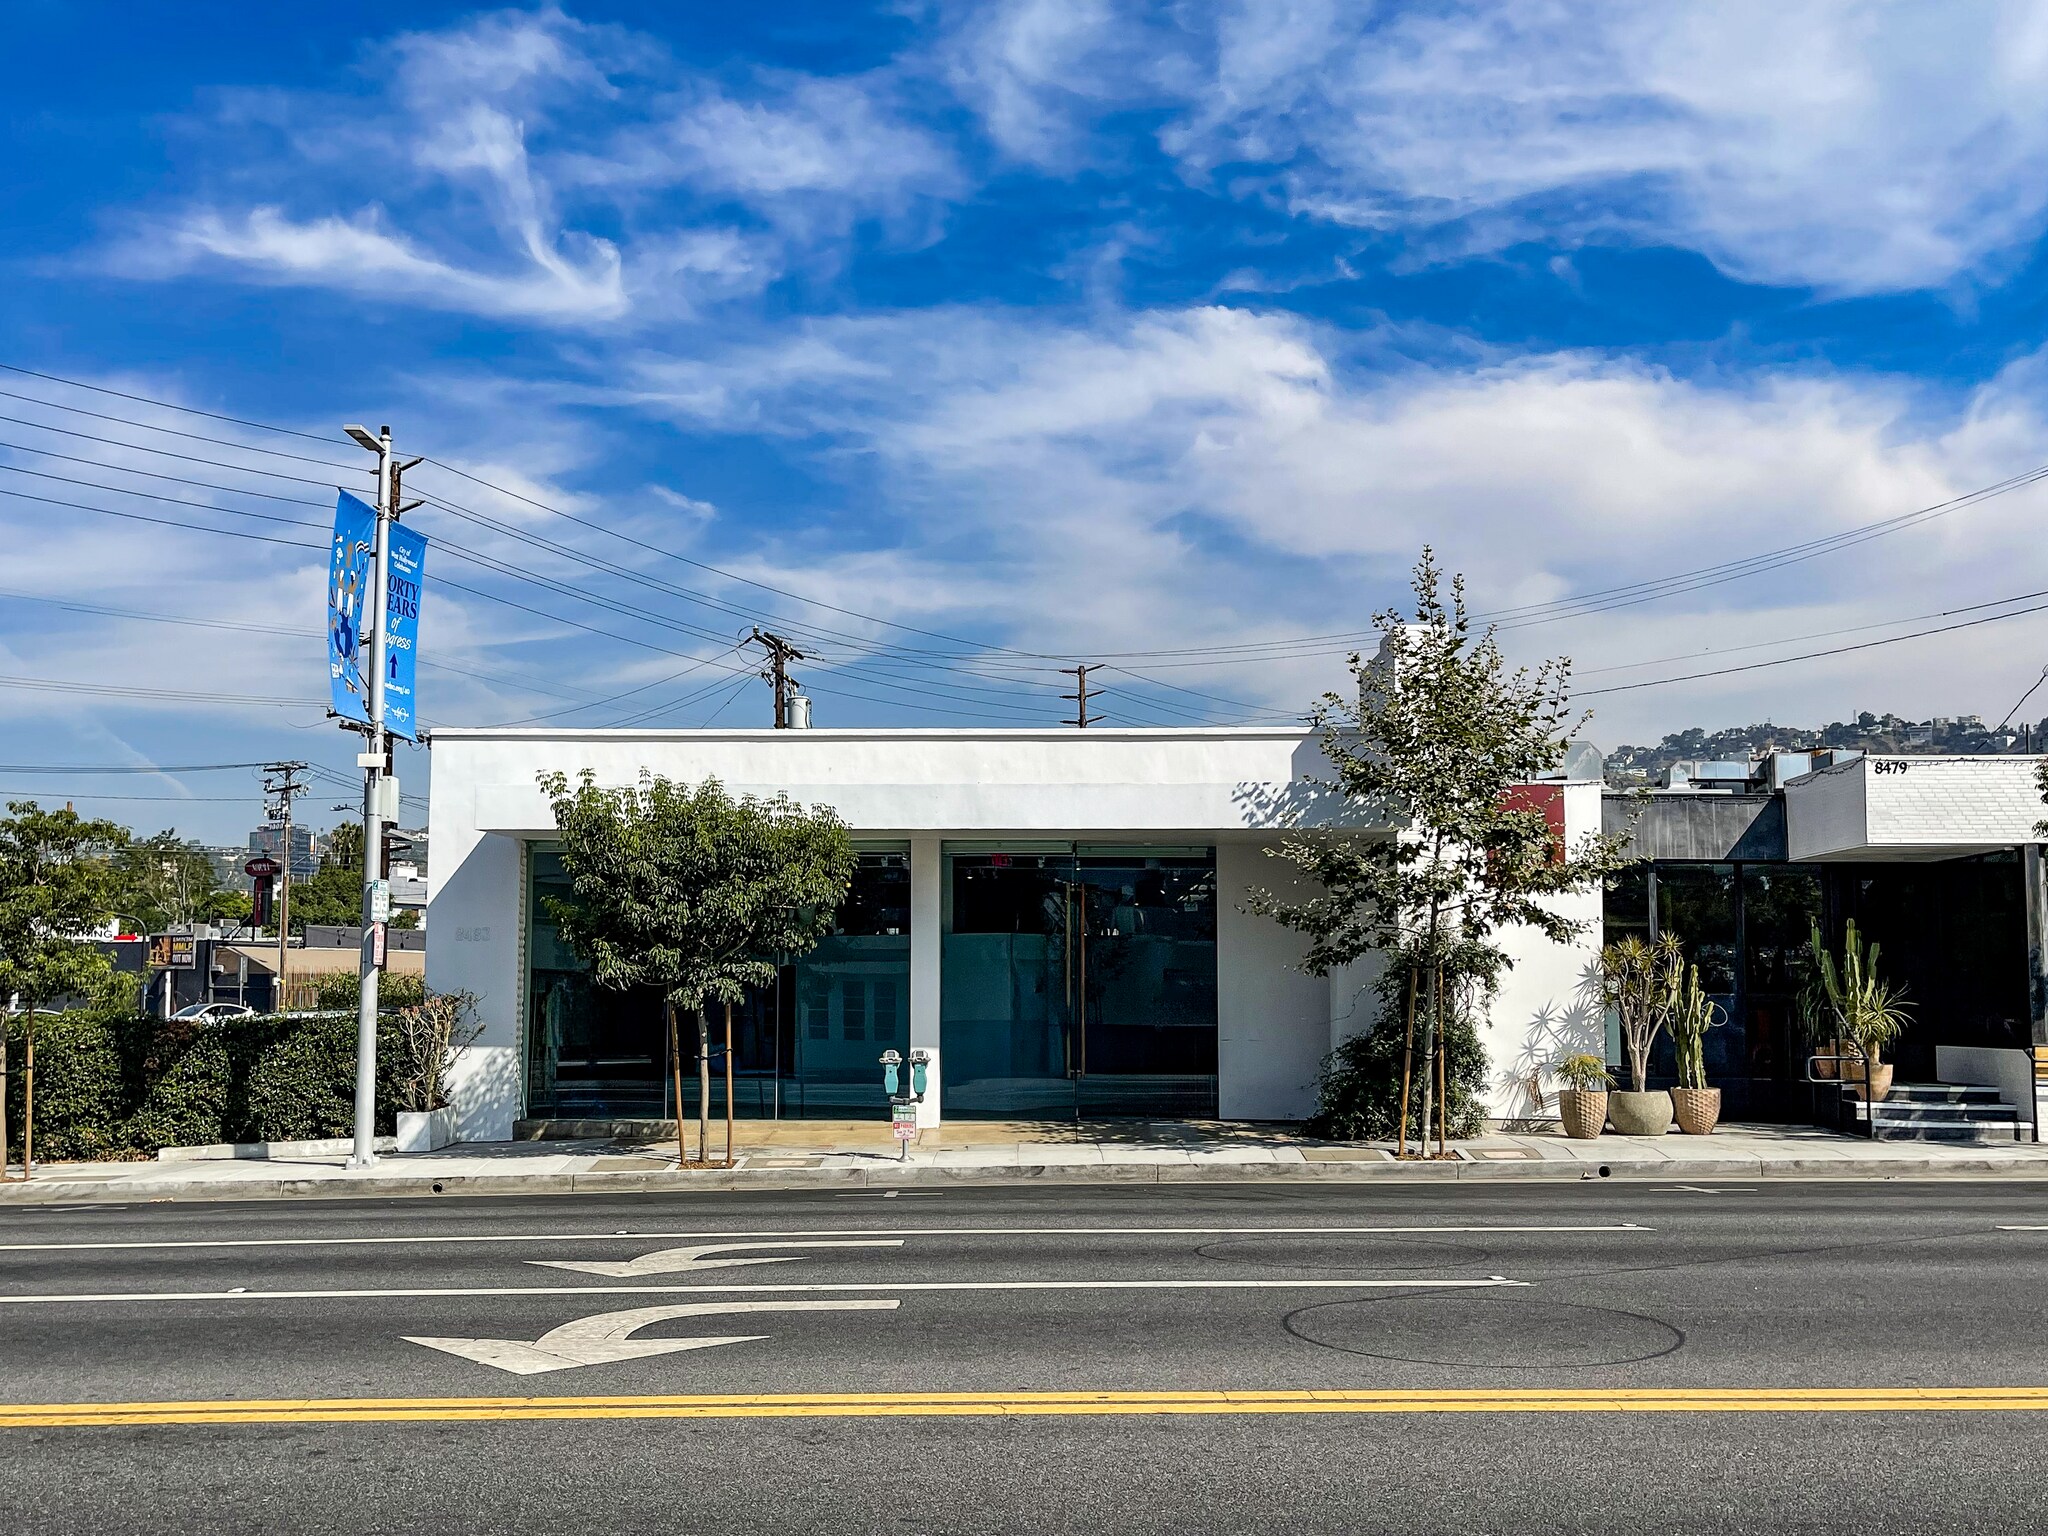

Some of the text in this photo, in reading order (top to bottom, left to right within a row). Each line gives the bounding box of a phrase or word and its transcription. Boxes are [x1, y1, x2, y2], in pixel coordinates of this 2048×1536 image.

[387, 573, 420, 602] ORTY
[387, 591, 418, 620] EARS
[390, 617, 402, 634] of
[385, 631, 412, 650] ogress
[1874, 761, 1908, 775] 8479
